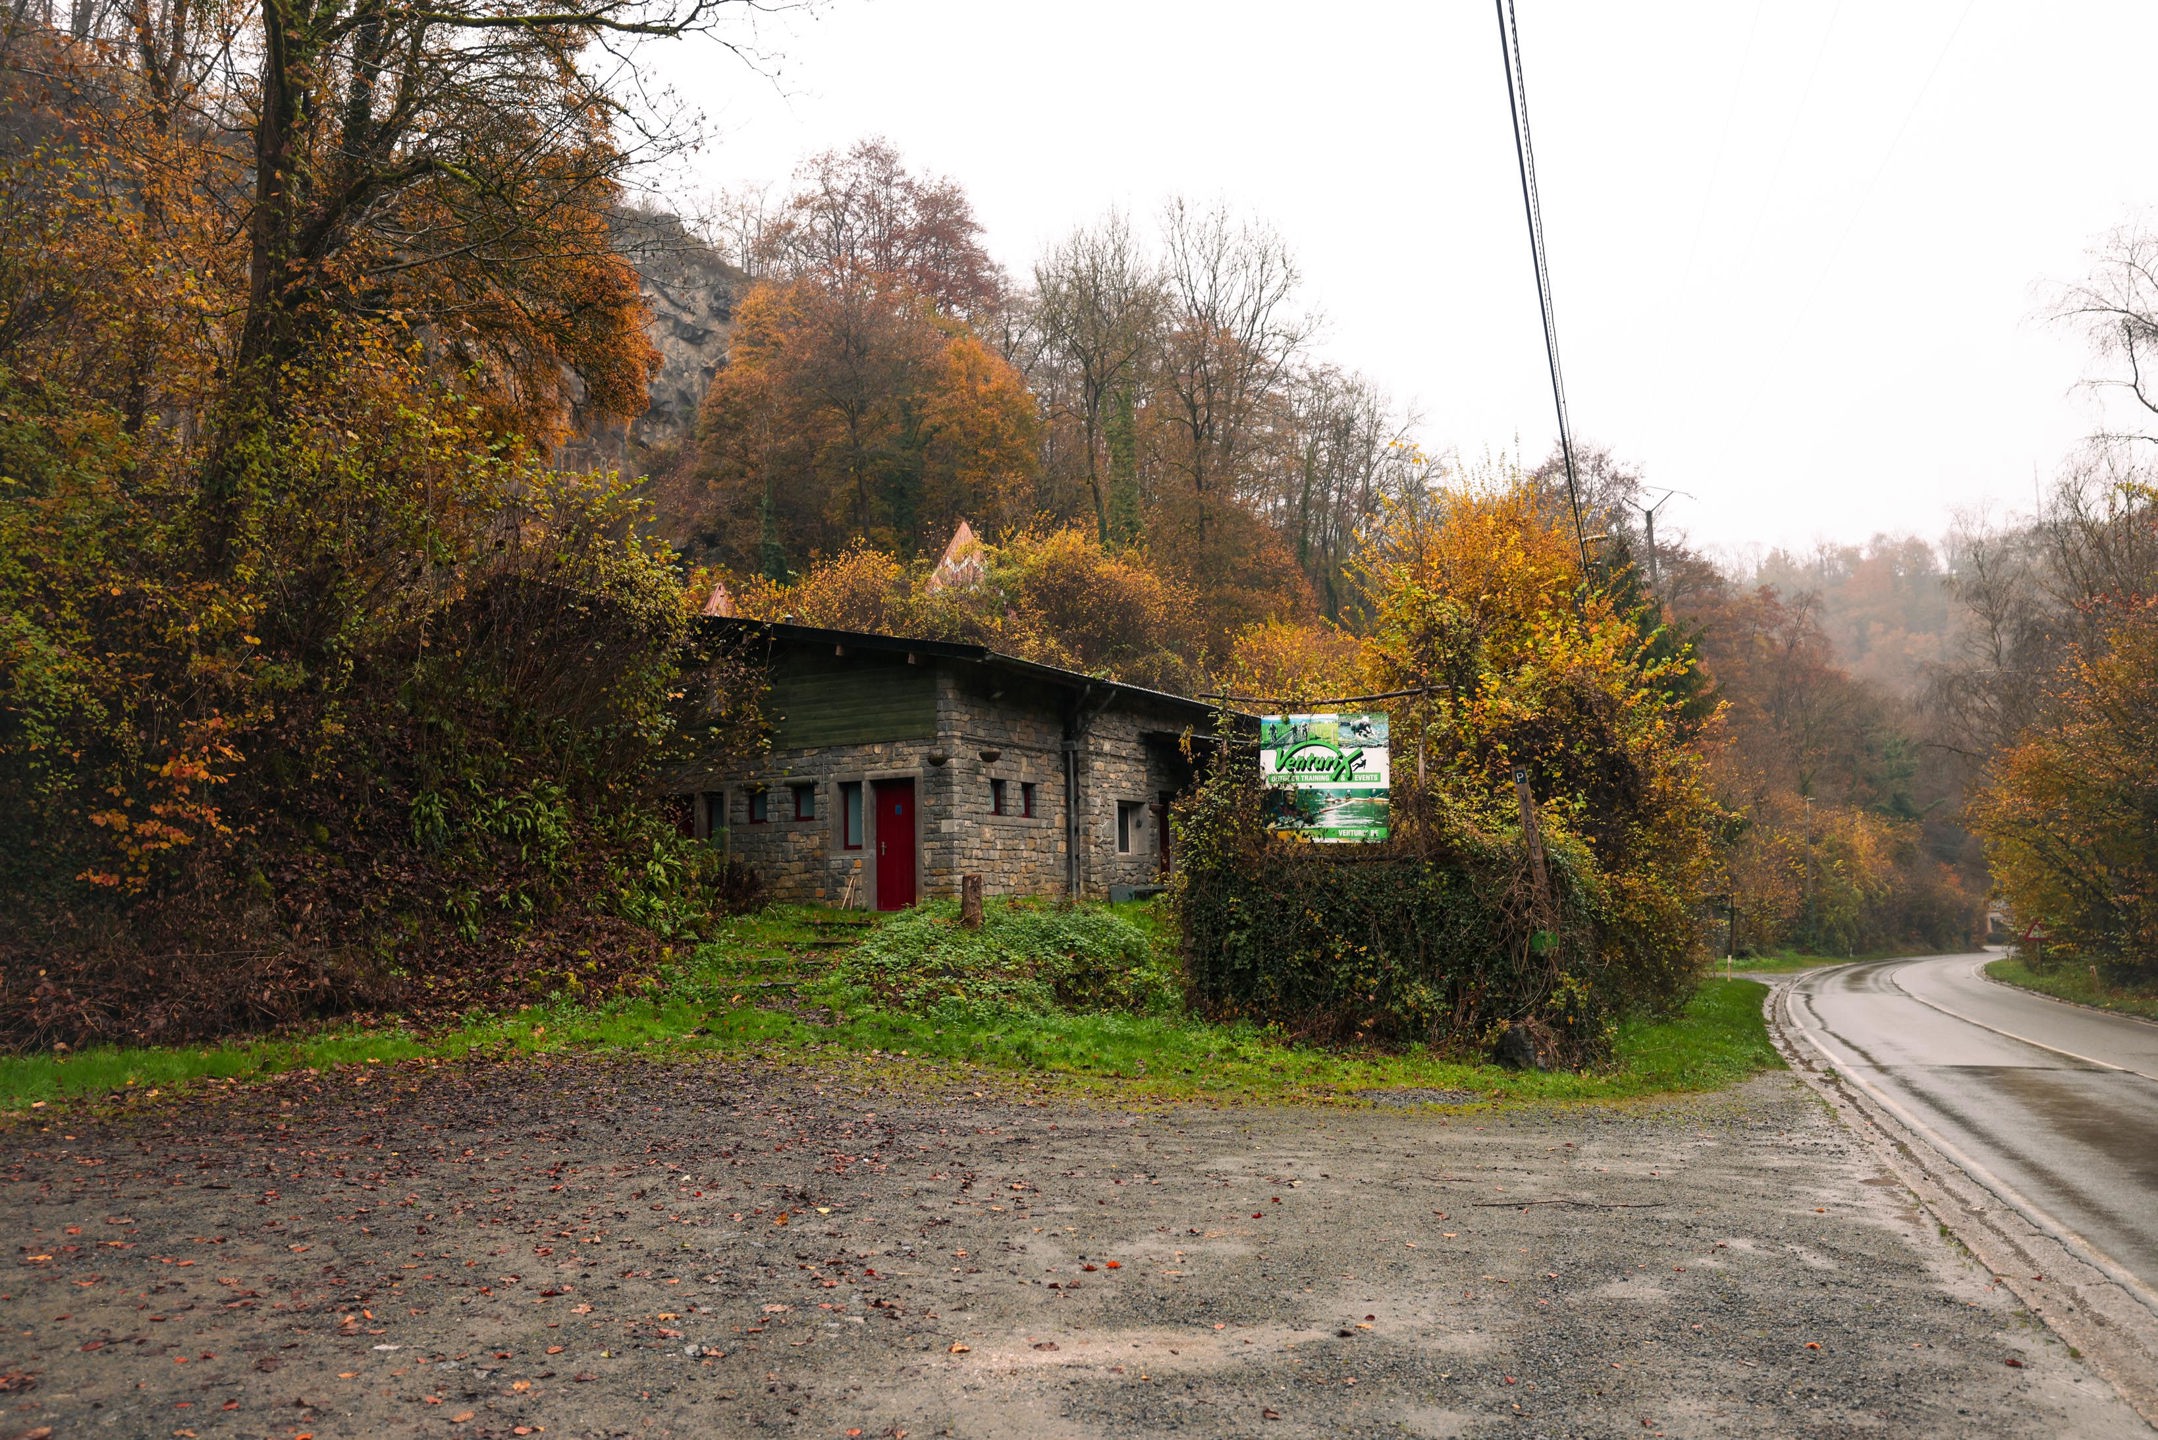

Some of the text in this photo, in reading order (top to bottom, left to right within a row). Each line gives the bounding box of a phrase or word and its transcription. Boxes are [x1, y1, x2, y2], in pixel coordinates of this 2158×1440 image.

[1301, 773, 1329, 782] TRAINING
[1354, 773, 1378, 781] EVENTS
[1516, 772, 1524, 783] P
